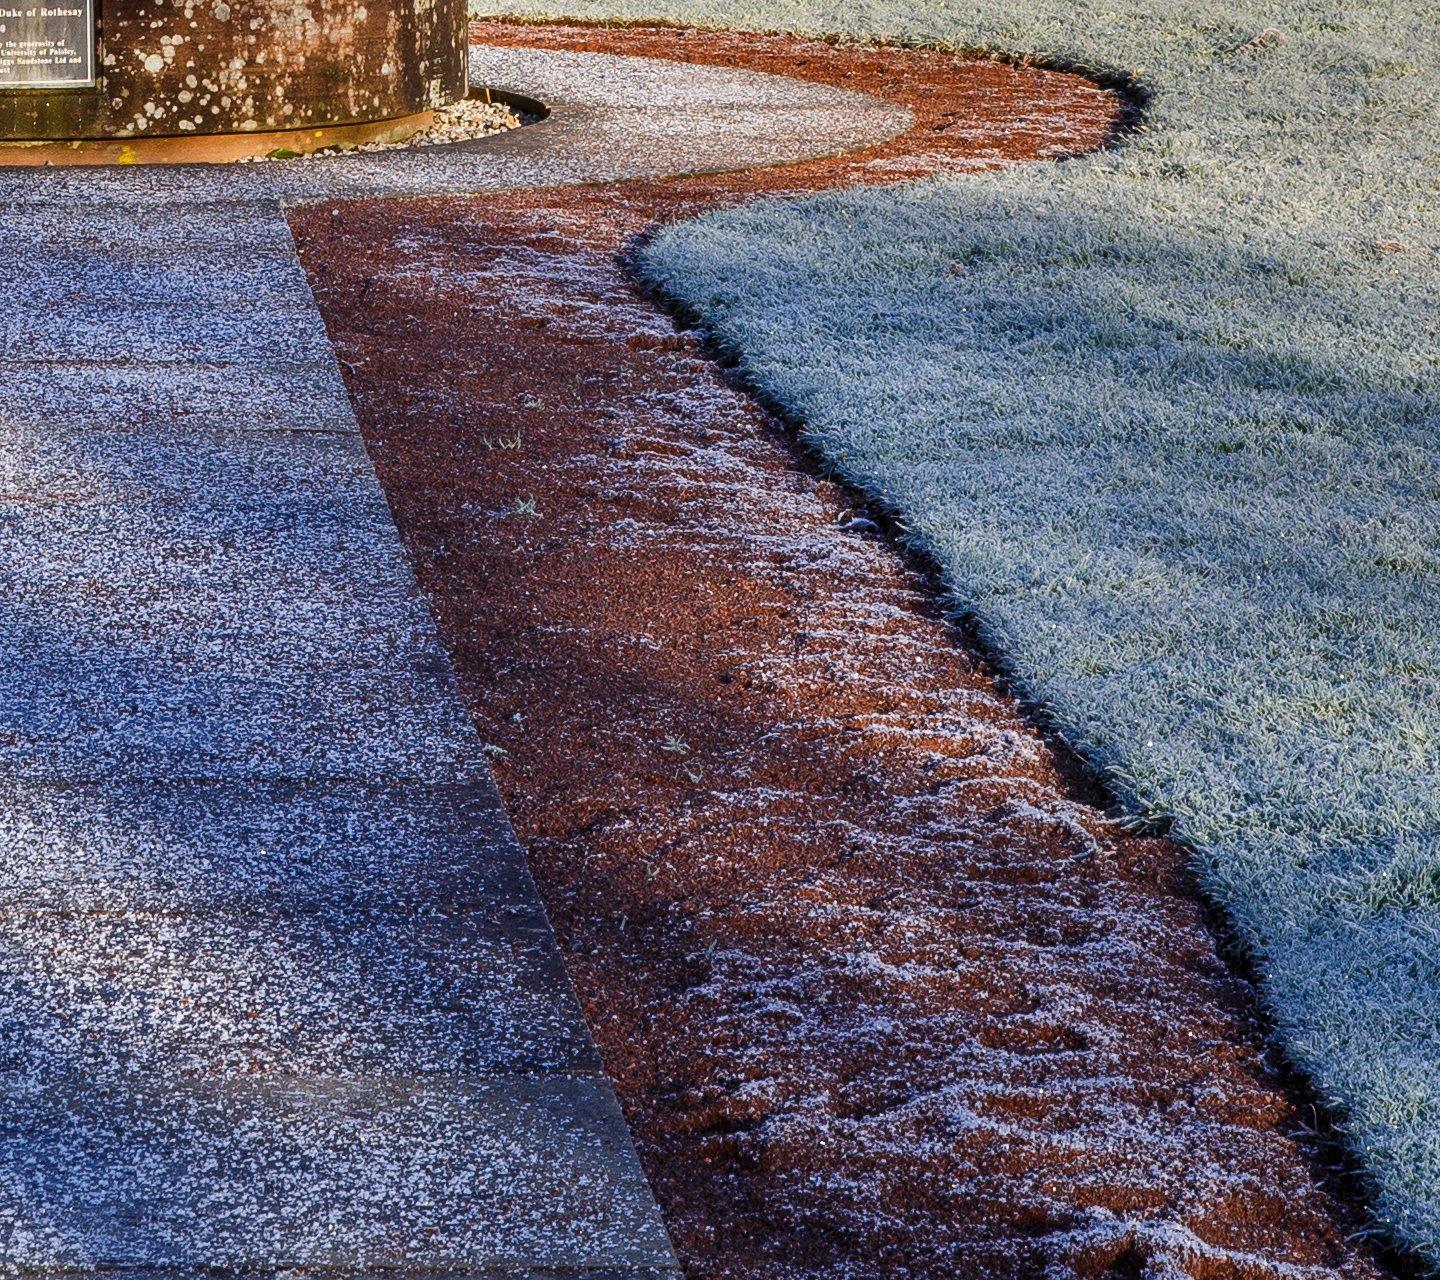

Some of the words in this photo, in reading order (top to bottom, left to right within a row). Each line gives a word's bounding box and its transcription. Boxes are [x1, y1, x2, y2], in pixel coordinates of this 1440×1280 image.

[26, 8, 37, 17] of
[40, 7, 83, 18] Rothesay
[57, 39, 65, 47] of
[1, 49, 37, 57] University
